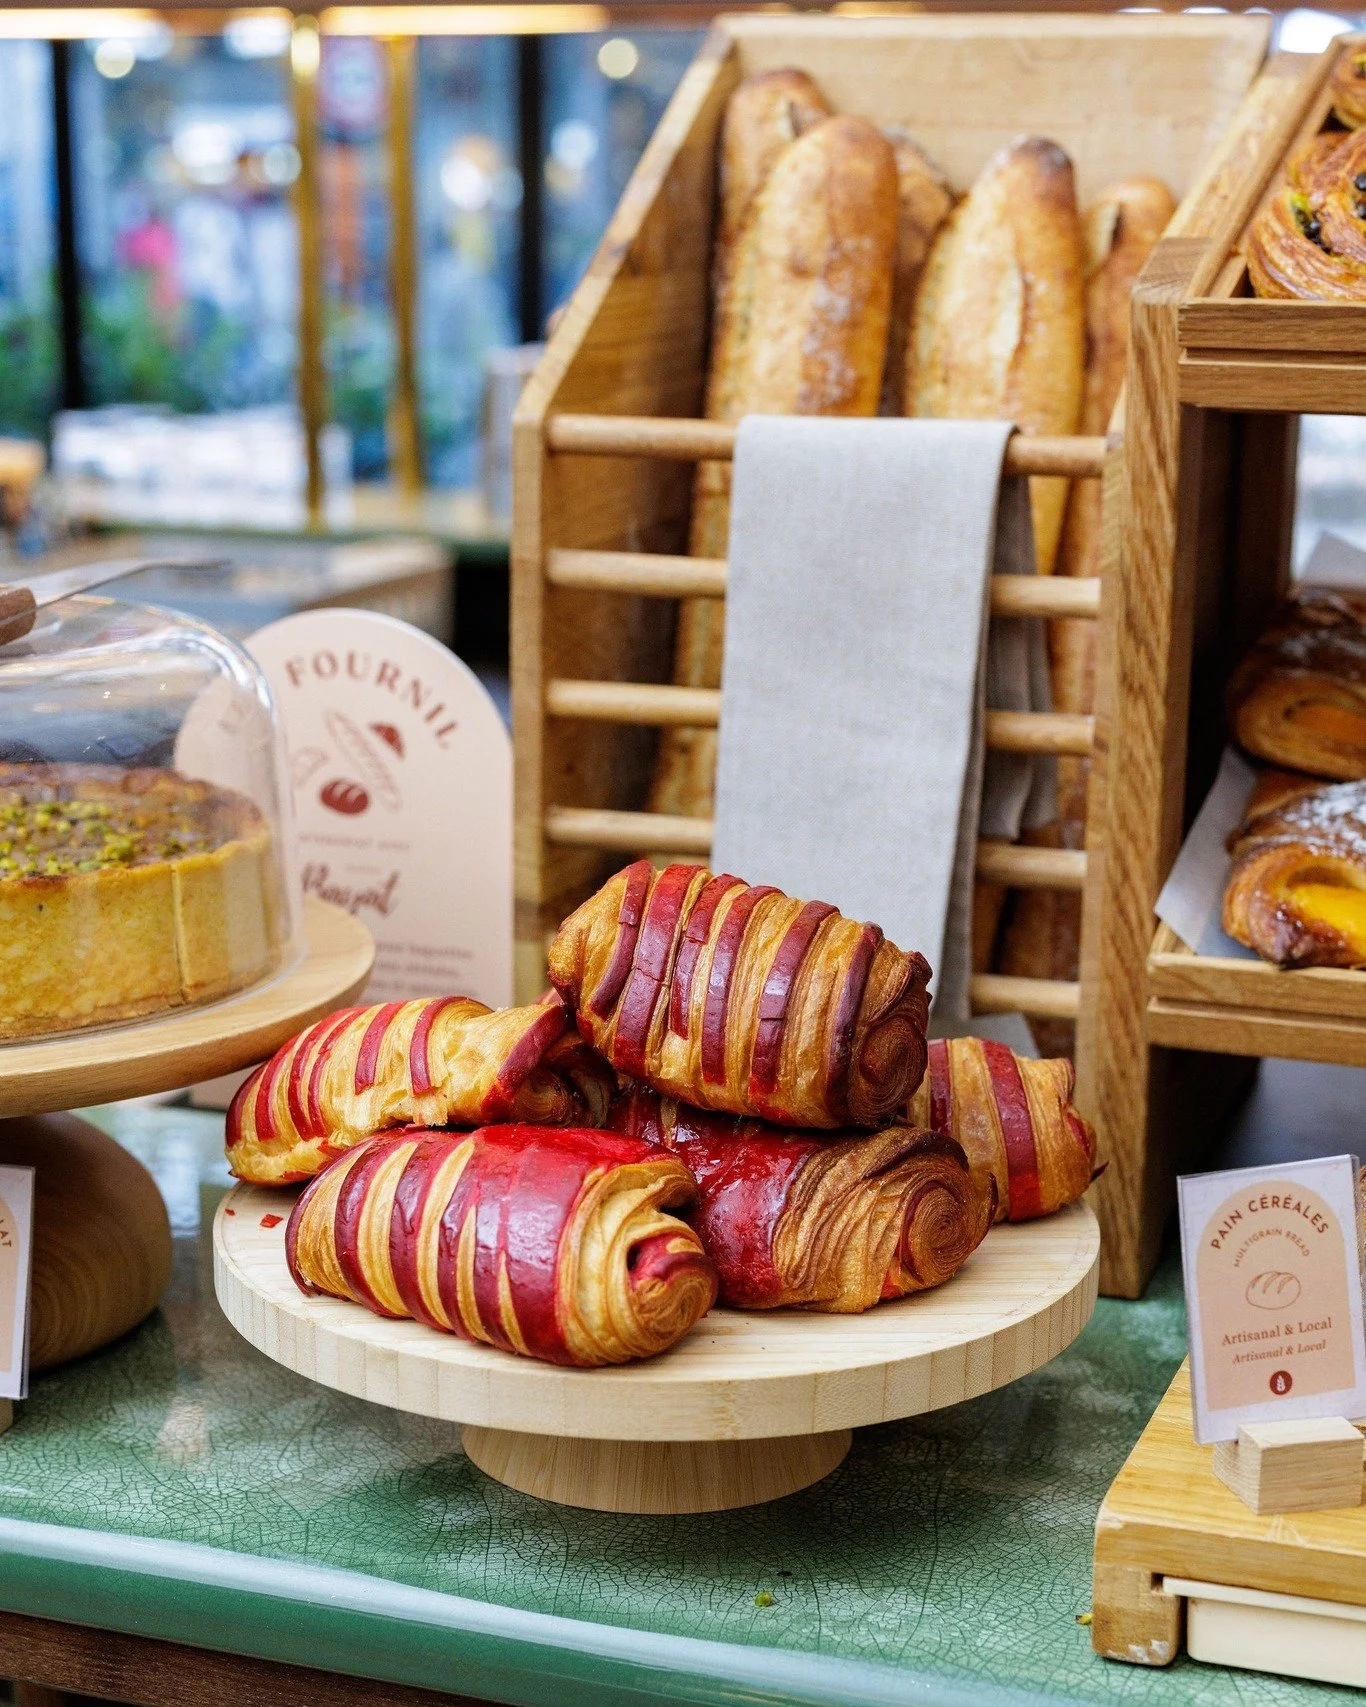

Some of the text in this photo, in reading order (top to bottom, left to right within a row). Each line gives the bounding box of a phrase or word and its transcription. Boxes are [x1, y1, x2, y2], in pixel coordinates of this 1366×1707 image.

[285, 651, 457, 748] FOURNIL
[0, 1218, 12, 1247] AT
[1211, 1194, 1329, 1249] PAIN CÉRÉALES
[1234, 1228, 1310, 1268] MULTIGRAIN BREAD
[1222, 1317, 1332, 1346] Artisanal & Local
[1232, 1340, 1326, 1365] Artisanal & Local
